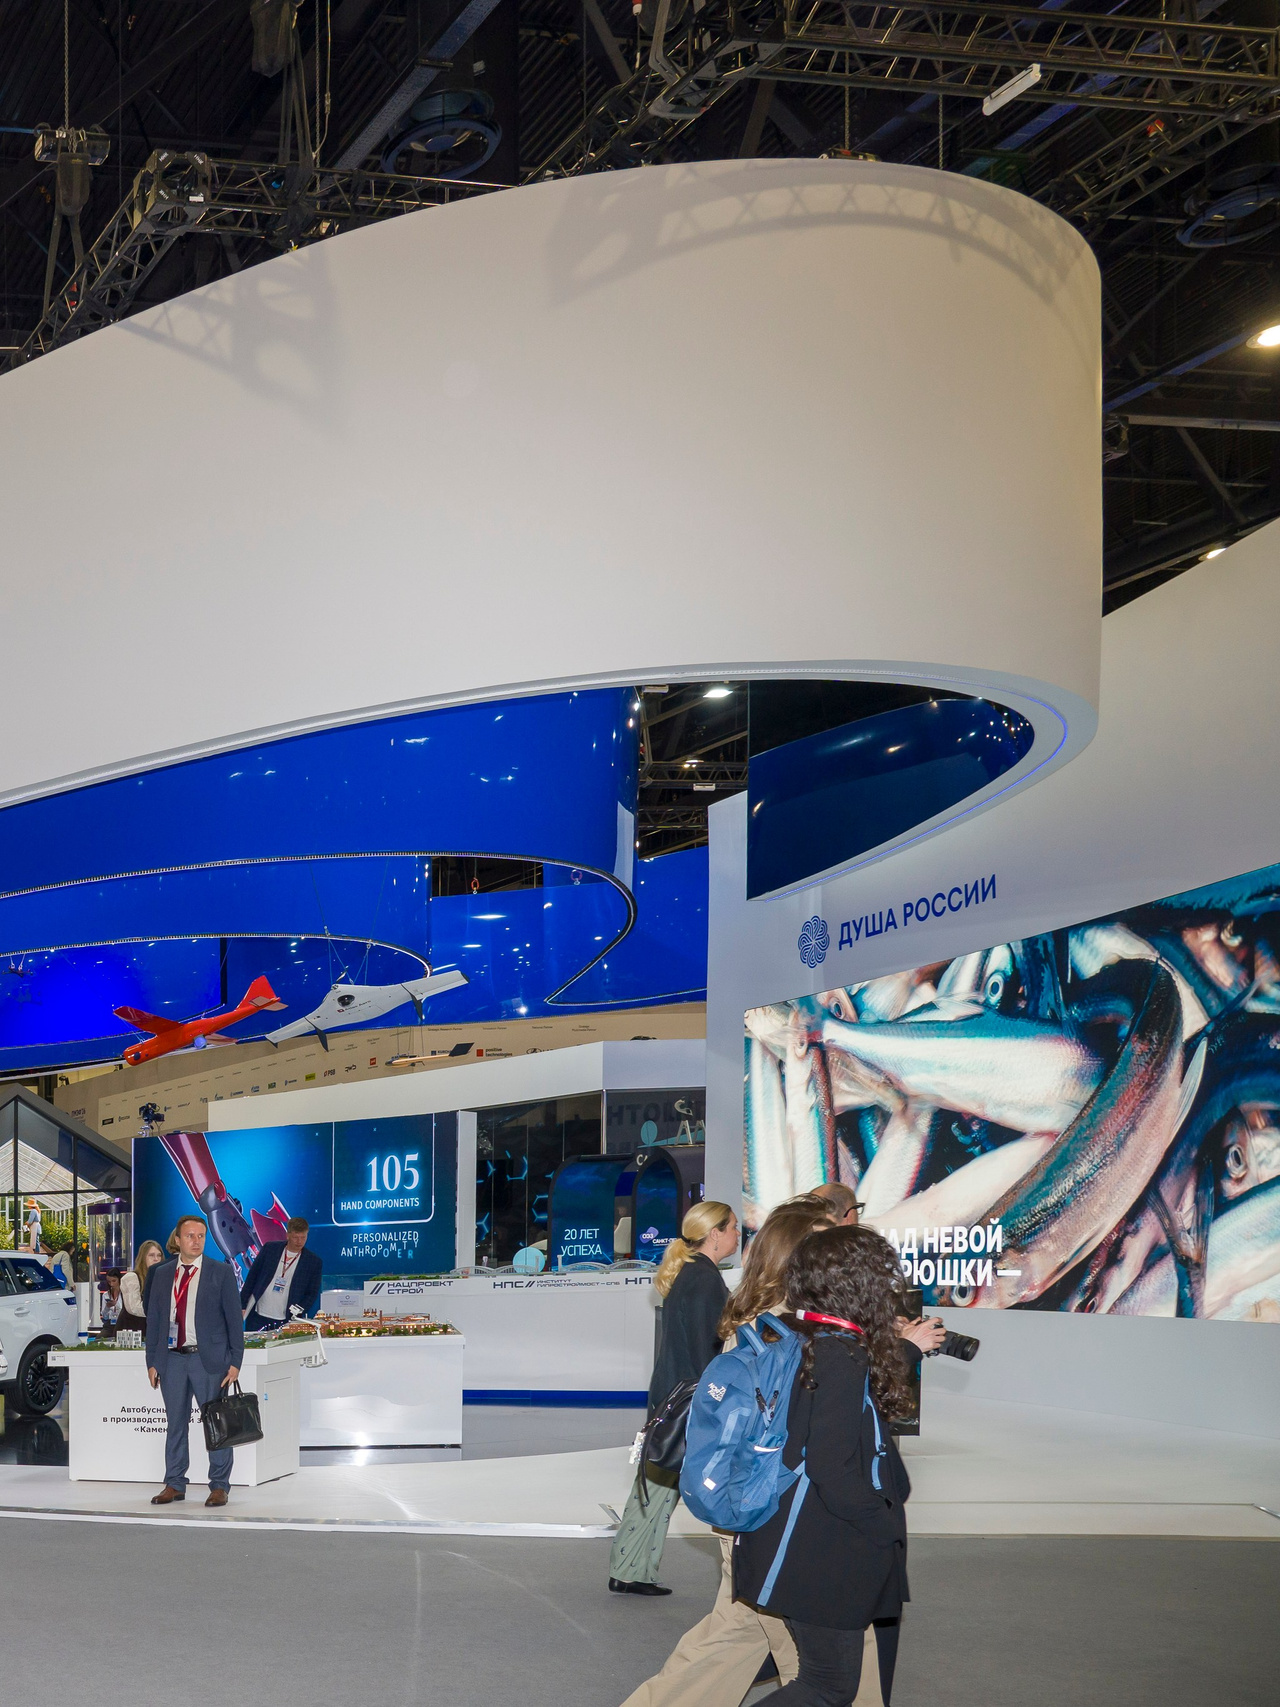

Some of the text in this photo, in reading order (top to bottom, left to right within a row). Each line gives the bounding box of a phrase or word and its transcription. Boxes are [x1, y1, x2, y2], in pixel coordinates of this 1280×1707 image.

[838, 873, 997, 950] ДУША РОССИИ
[367, 1152, 419, 1192] 105
[340, 1197, 419, 1211] HAND COMPONENTS
[352, 1231, 419, 1243] PERSONALIZED
[564, 1228, 599, 1240] 20 ЛЕТ
[880, 1218, 1002, 1259] АД НЕВОЙ
[561, 1244, 602, 1257] УСПЕХА
[900, 1259, 992, 1286] РЮШКИ
[387, 1281, 454, 1289] НАЦПРОЕКТ
[493, 1281, 524, 1289] НПС
[625, 1277, 653, 1285] НП
[387, 1287, 424, 1295] СТРОЙ
